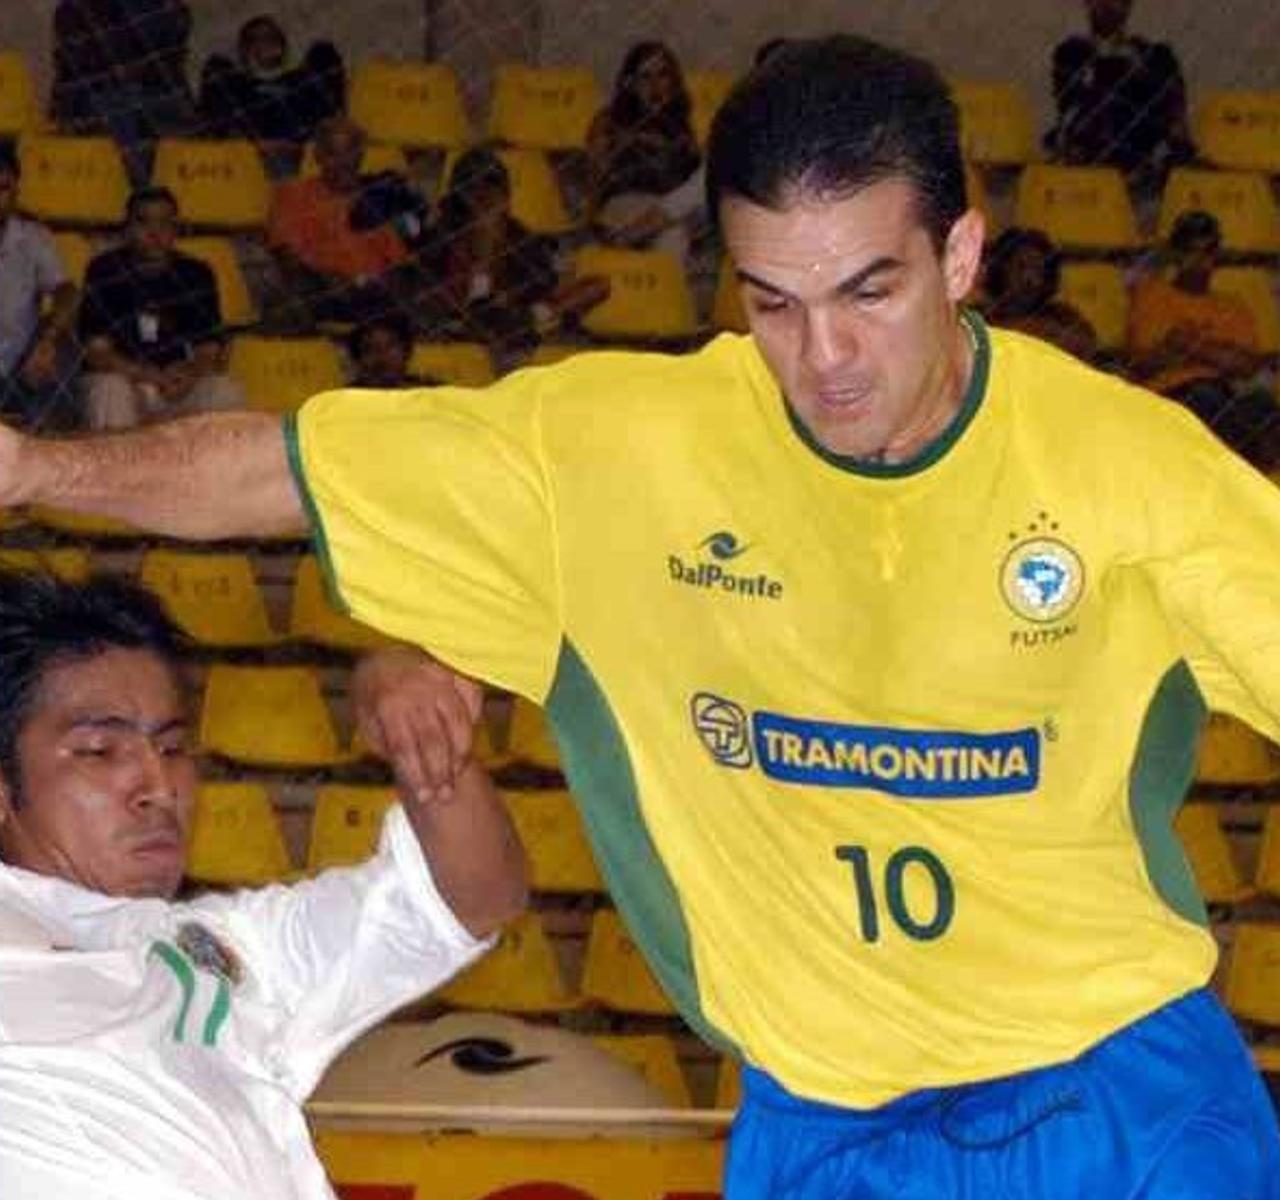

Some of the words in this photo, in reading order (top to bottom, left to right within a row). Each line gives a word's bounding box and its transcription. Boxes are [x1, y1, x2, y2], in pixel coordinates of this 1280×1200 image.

[668, 555, 783, 599] DalPonte
[763, 729, 1030, 782] TRAMONTINA
[835, 844, 955, 944] 10
